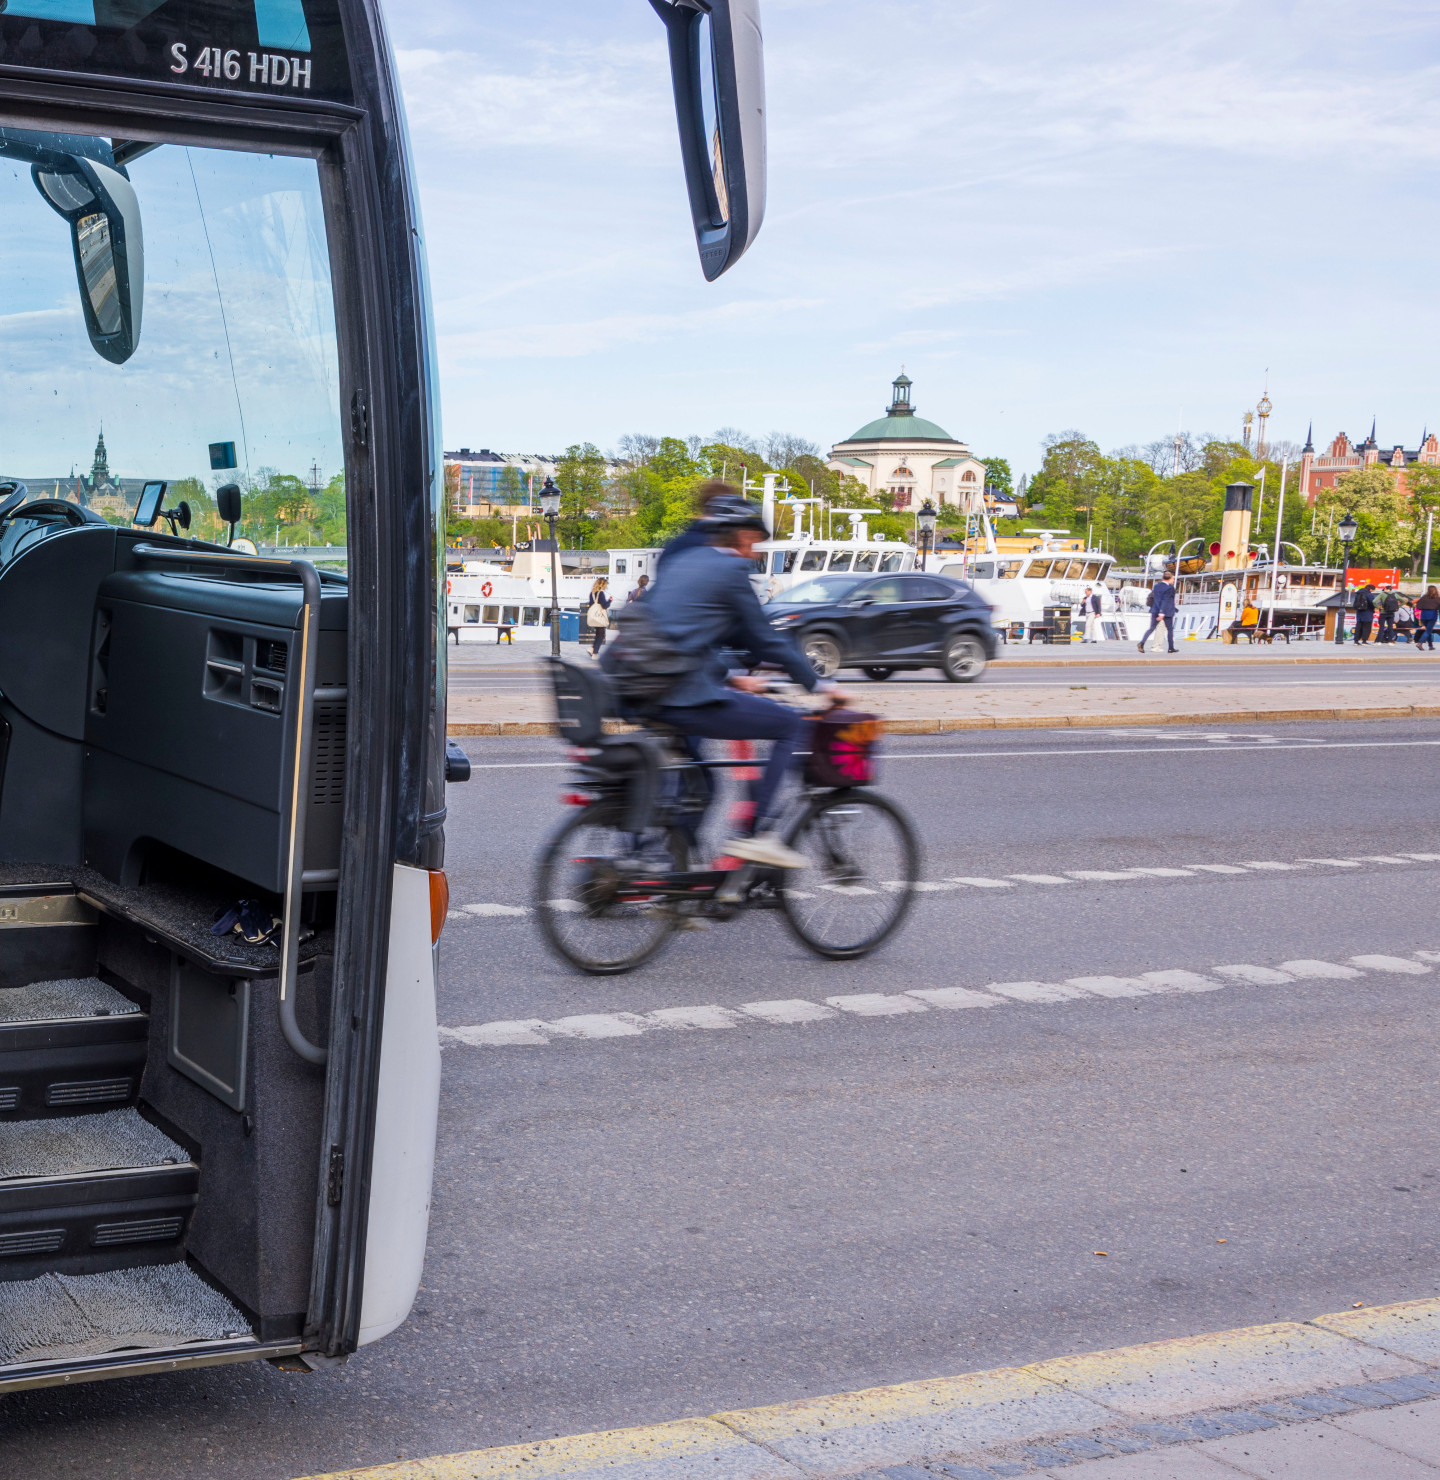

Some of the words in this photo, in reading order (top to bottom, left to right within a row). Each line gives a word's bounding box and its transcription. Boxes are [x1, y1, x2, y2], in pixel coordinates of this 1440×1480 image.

[170, 42, 188, 74] S
[193, 47, 241, 80] 416
[247, 52, 312, 89] HDH
